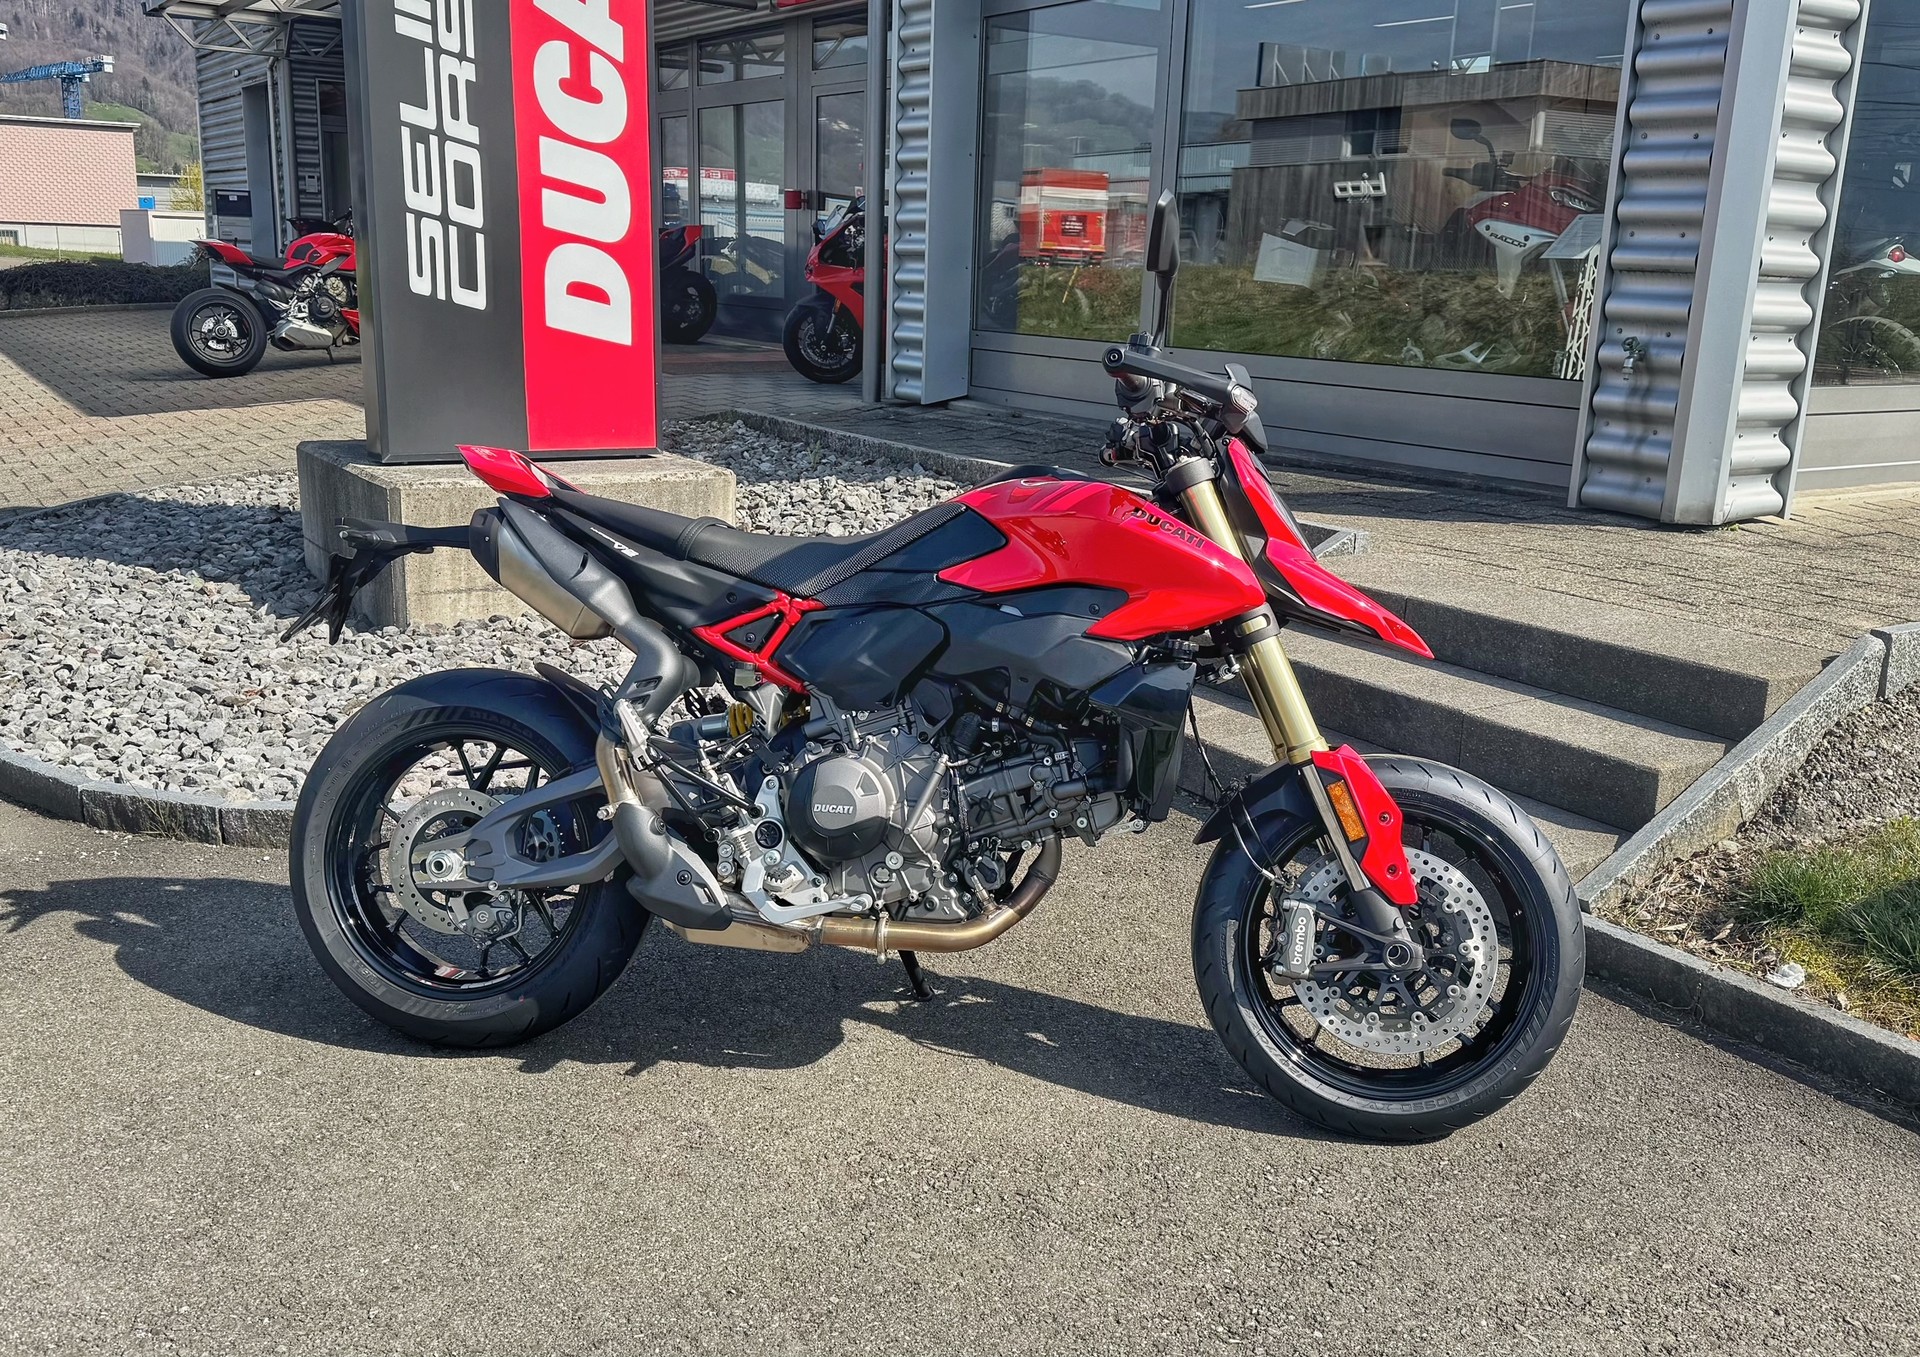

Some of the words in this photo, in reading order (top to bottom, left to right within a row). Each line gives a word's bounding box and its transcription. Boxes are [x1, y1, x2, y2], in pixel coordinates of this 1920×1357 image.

[1131, 507, 1205, 549] DUCATI
[813, 803, 854, 814] DUCATI
[1290, 916, 1307, 965] brembo
